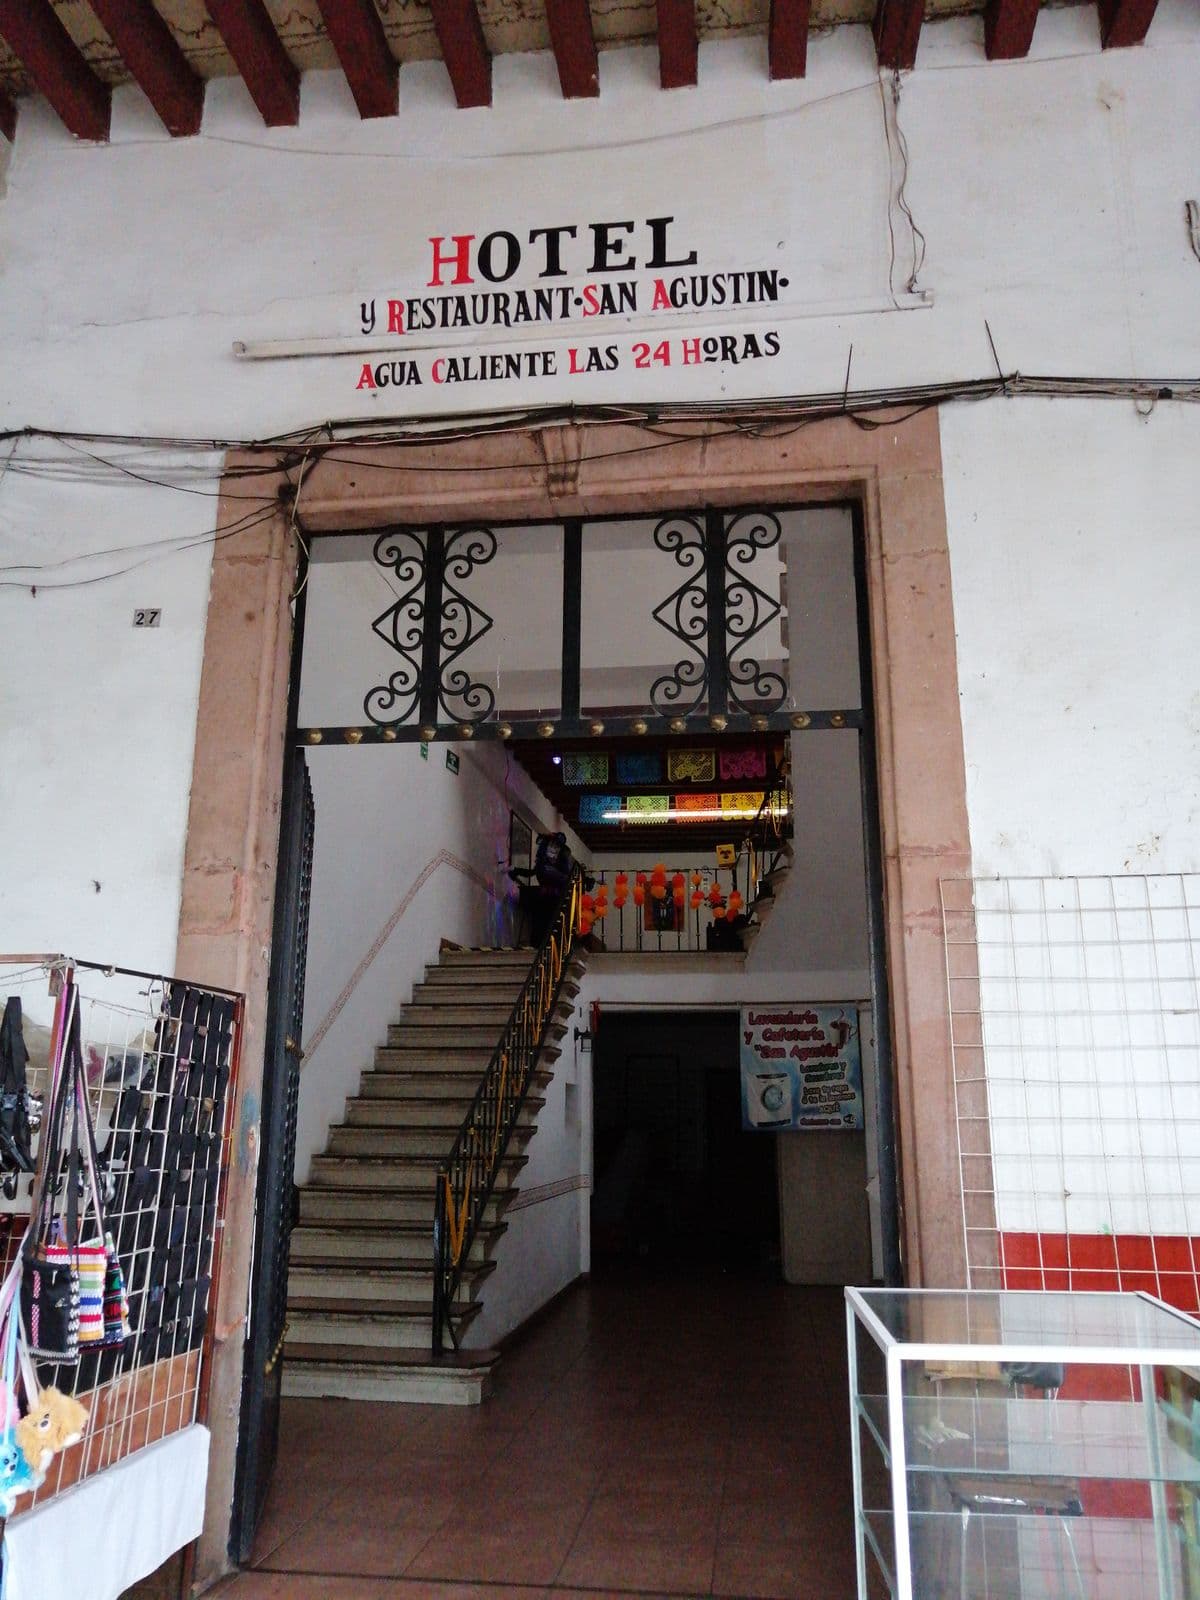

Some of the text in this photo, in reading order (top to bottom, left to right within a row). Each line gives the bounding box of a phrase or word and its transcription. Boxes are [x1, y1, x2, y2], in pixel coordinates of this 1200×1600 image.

[427, 217, 697, 287] HOTEL
[356, 331, 780, 389] AGUA CALIENTE LAS 24 HORAS
[135, 611, 158, 625] 27
